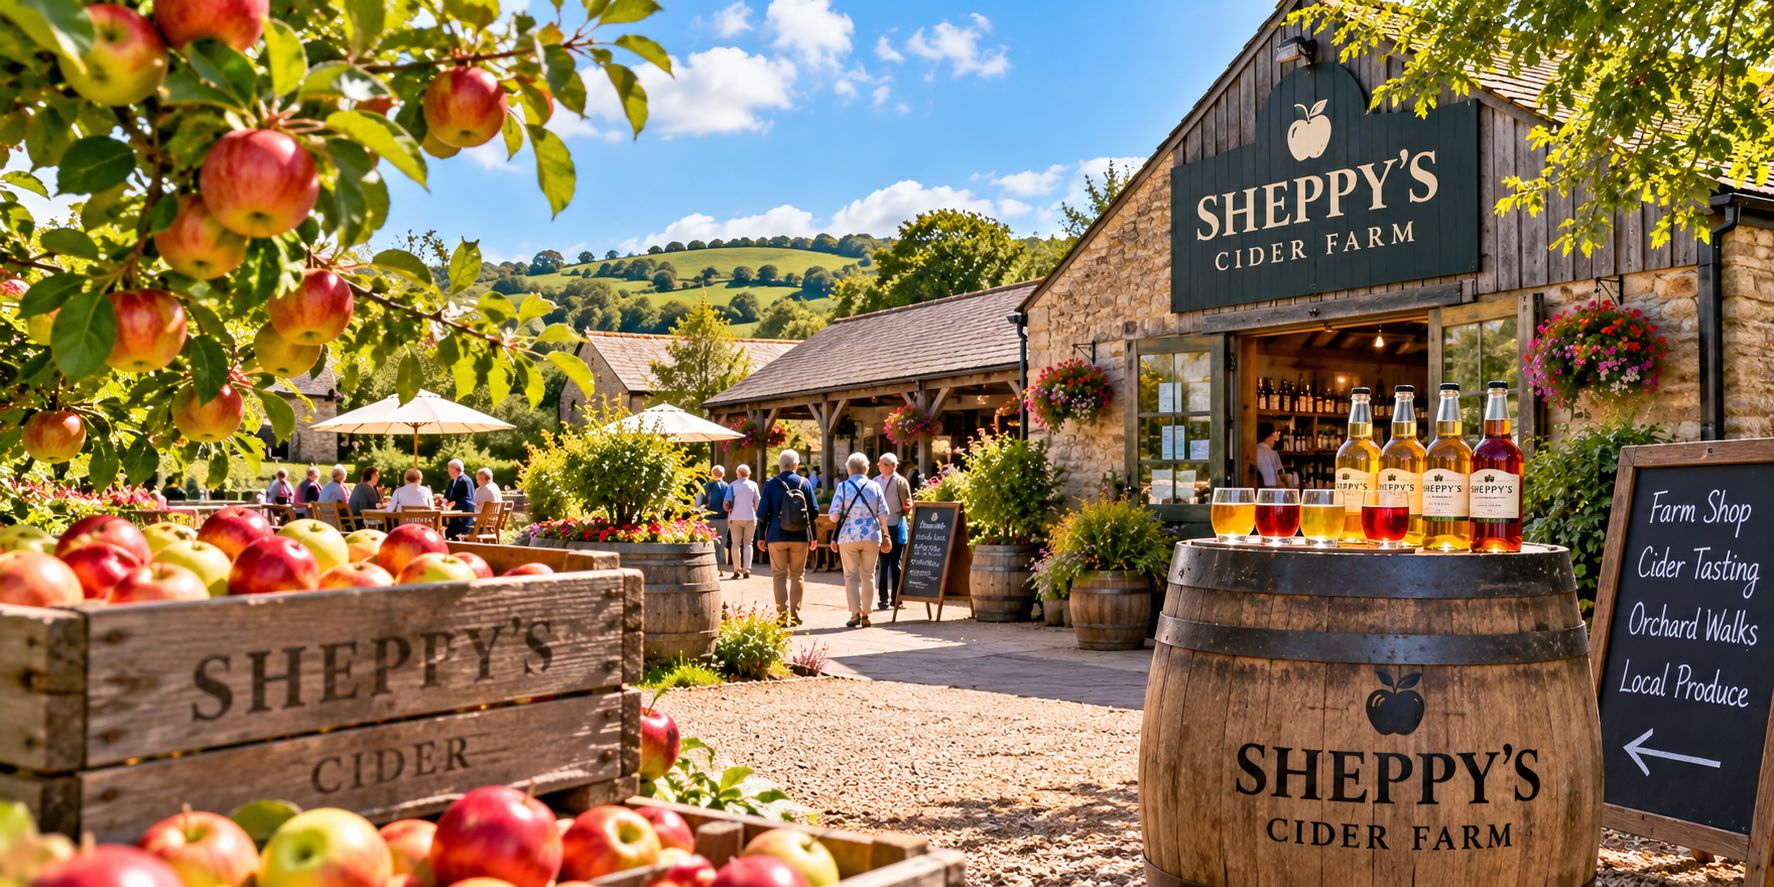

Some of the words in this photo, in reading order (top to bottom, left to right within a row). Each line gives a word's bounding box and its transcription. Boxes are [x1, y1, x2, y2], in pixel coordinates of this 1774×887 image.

[1196, 148, 1438, 241] SHEPPY'S
[1215, 239, 1307, 271] CIDER
[1326, 221, 1415, 255] FARM
[1470, 485, 1513, 494] SHEPPY'S
[1650, 490, 1696, 524] Farm
[1703, 489, 1752, 538] Shop
[1638, 545, 1686, 579] Cider
[1693, 546, 1760, 599] Tasting
[1628, 601, 1701, 640] Orchard
[1705, 608, 1758, 646] Walks
[191, 616, 553, 722] SHEPPY'S
[1619, 658, 1670, 697] Local
[1674, 663, 1749, 708] Produce
[311, 736, 471, 794] CIDER
[1235, 742, 1541, 805] SHEPPY'S
[1267, 817, 1390, 850] CIDER
[1411, 822, 1513, 851] FARM
